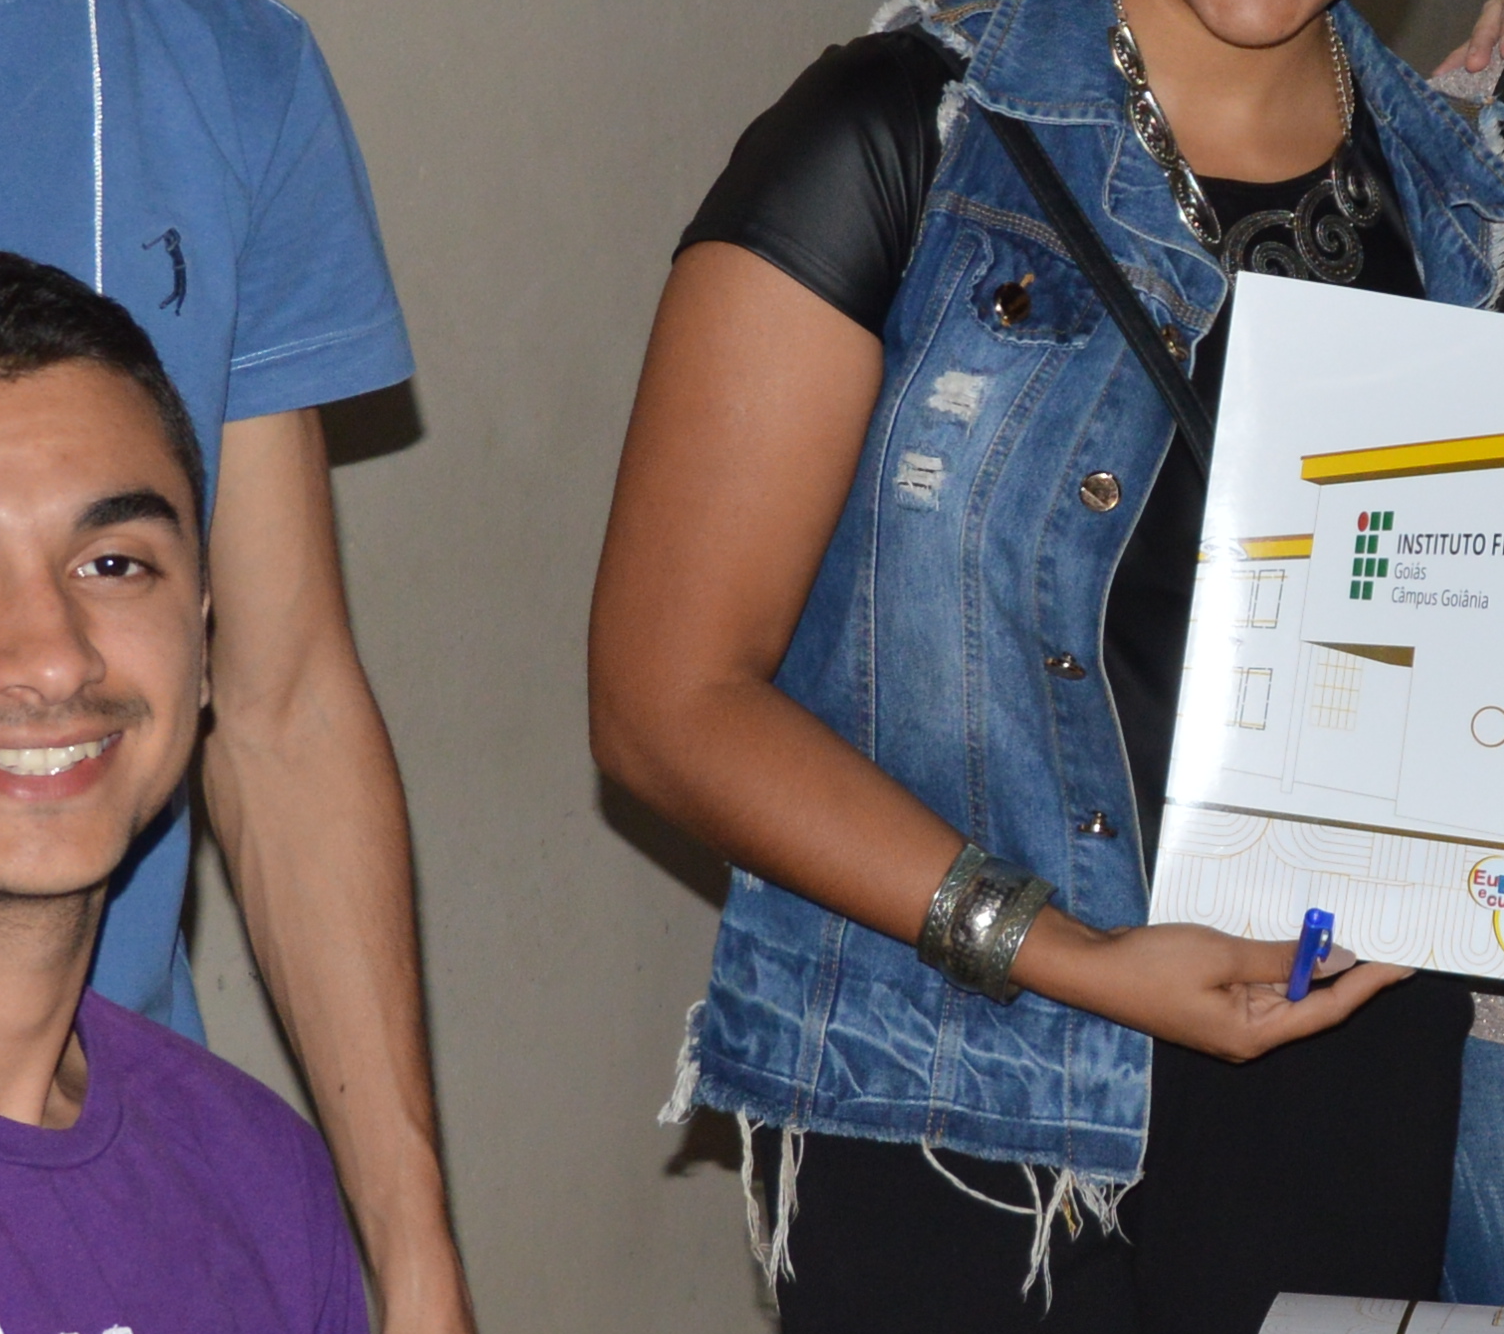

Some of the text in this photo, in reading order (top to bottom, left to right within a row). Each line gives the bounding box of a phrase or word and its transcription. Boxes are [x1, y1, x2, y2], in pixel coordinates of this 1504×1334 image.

[1397, 533, 1486, 556] INSTITUTO
[1394, 561, 1427, 581] Goiás
[1391, 586, 1489, 609] Câmpus Goiânia
[1473, 869, 1499, 887] Eu
